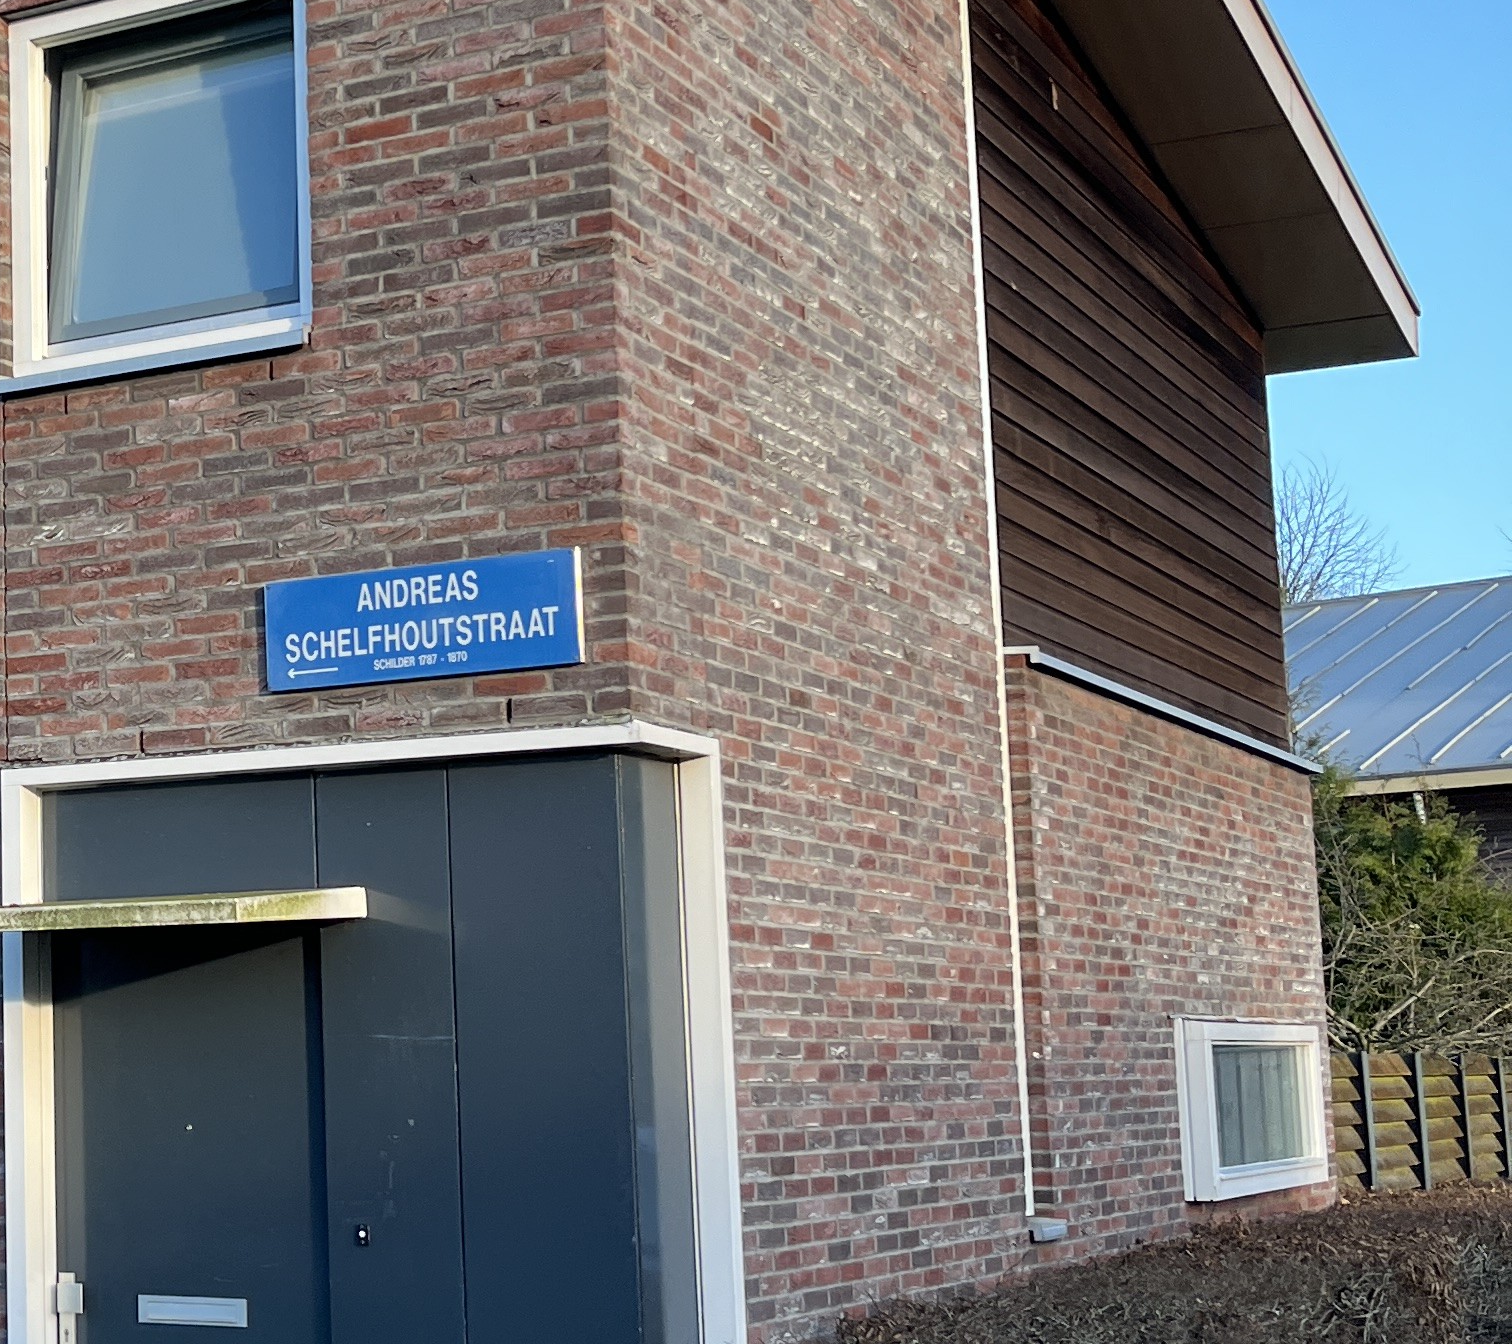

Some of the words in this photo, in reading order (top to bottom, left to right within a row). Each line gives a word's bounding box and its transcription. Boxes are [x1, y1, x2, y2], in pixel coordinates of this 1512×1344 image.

[356, 569, 479, 612] ANDREAS
[285, 605, 559, 664] SCHELFHOUTSTRAAT
[373, 655, 416, 671] SCHILDER
[418, 653, 438, 666] 1787
[447, 650, 468, 663] 1870
